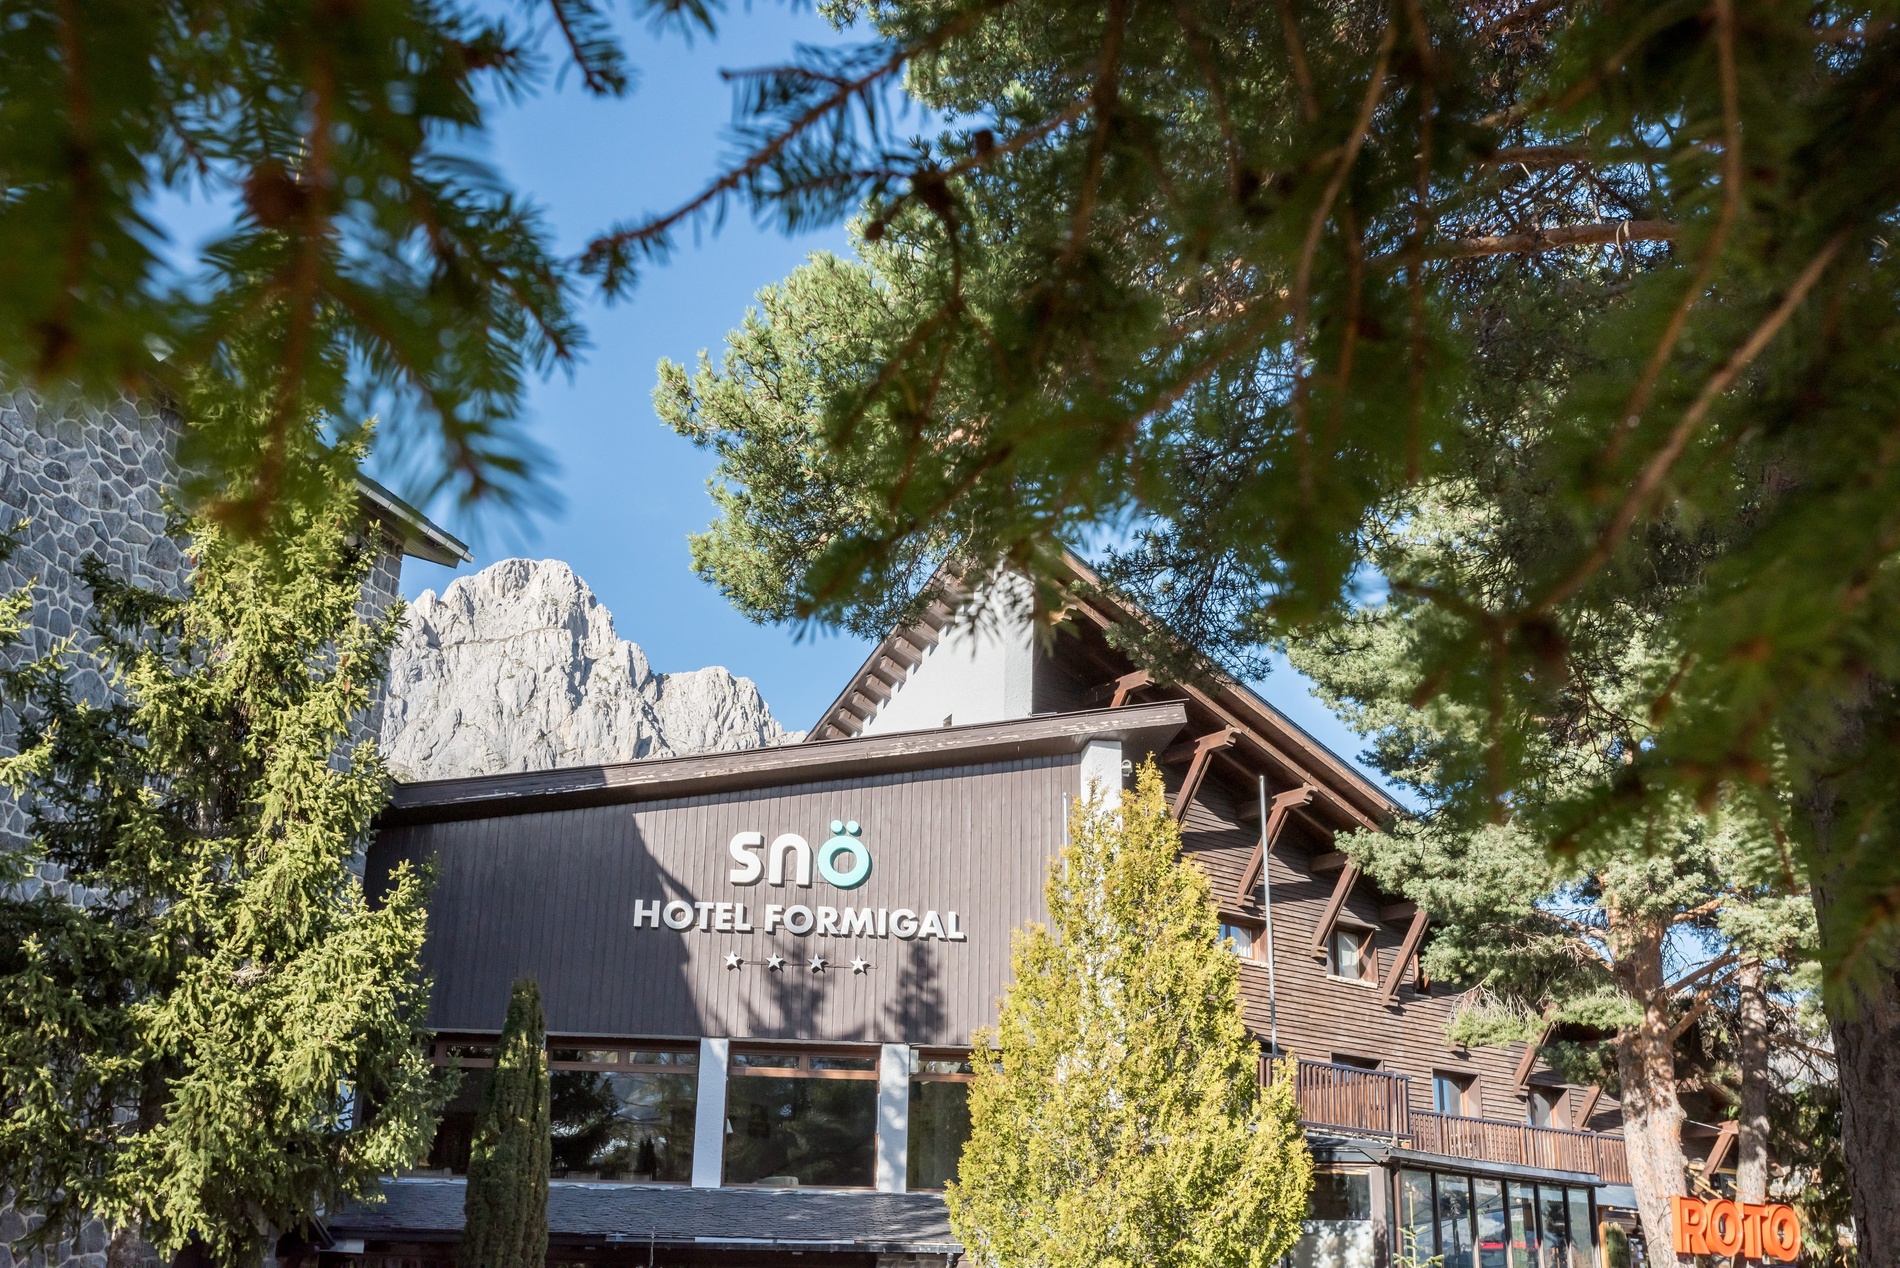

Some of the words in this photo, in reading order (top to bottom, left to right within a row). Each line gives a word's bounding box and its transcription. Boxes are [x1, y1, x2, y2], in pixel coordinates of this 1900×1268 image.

[633, 899, 753, 932] HOTEL
[764, 904, 966, 941] FORMIGAL
[1672, 1195, 1801, 1262] ROTO
